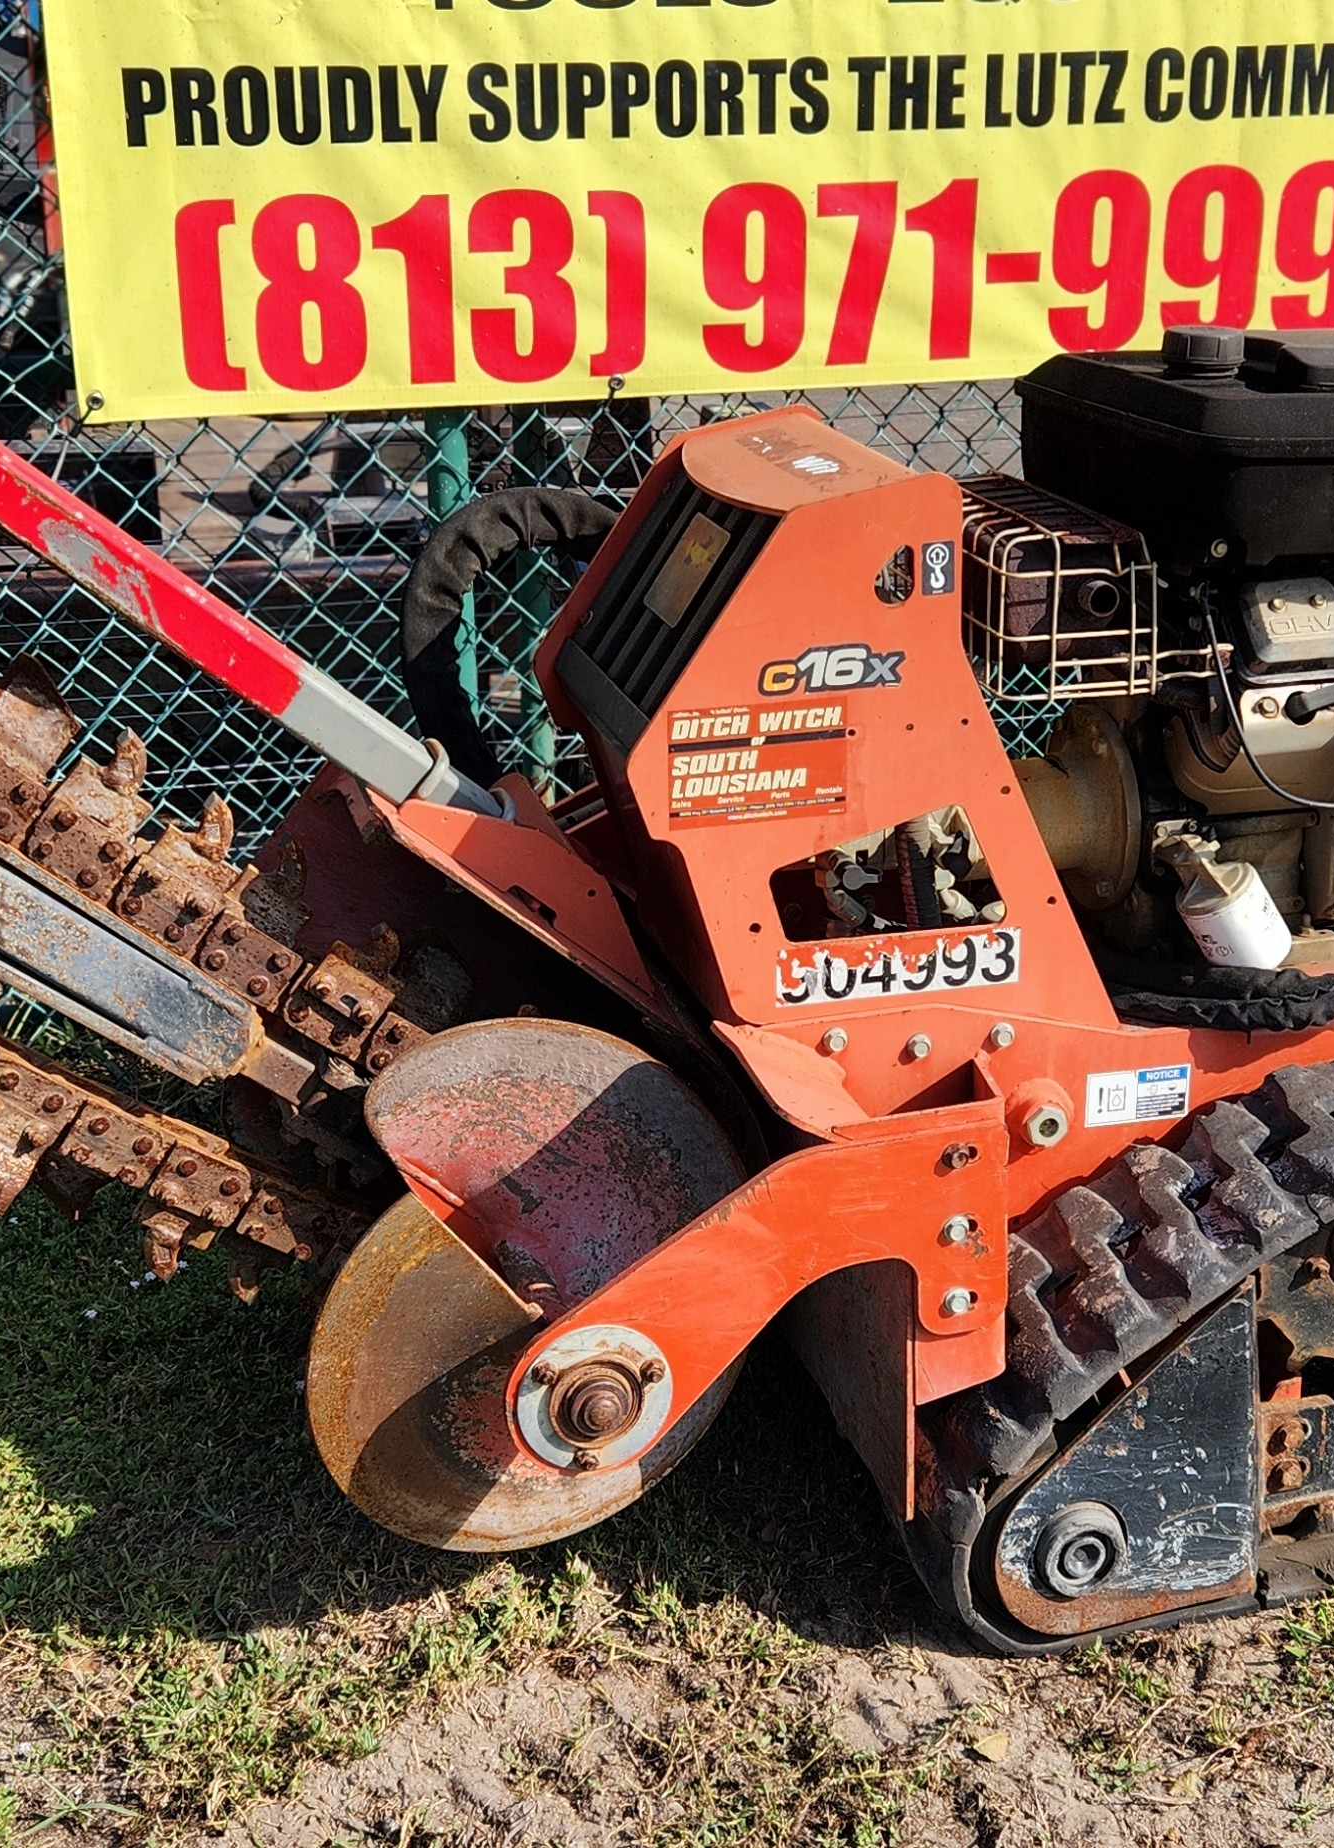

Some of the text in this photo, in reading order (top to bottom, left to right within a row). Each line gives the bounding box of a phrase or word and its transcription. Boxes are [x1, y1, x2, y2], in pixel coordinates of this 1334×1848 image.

[120, 64, 448, 148] PROUDLY
[468, 57, 829, 143] SUPPORTS
[848, 55, 966, 133] THE
[984, 50, 1129, 128] LUTZ
[174, 188, 646, 392] (813)
[1268, 613, 1333, 636] OHV
[671, 714, 750, 741] DITCH
[671, 750, 759, 777] SOUTH
[671, 768, 808, 799] LOUISIANA
[671, 785, 843, 809] Sales Service Parts Rentals
[1146, 1069, 1180, 1081] NOTICE
